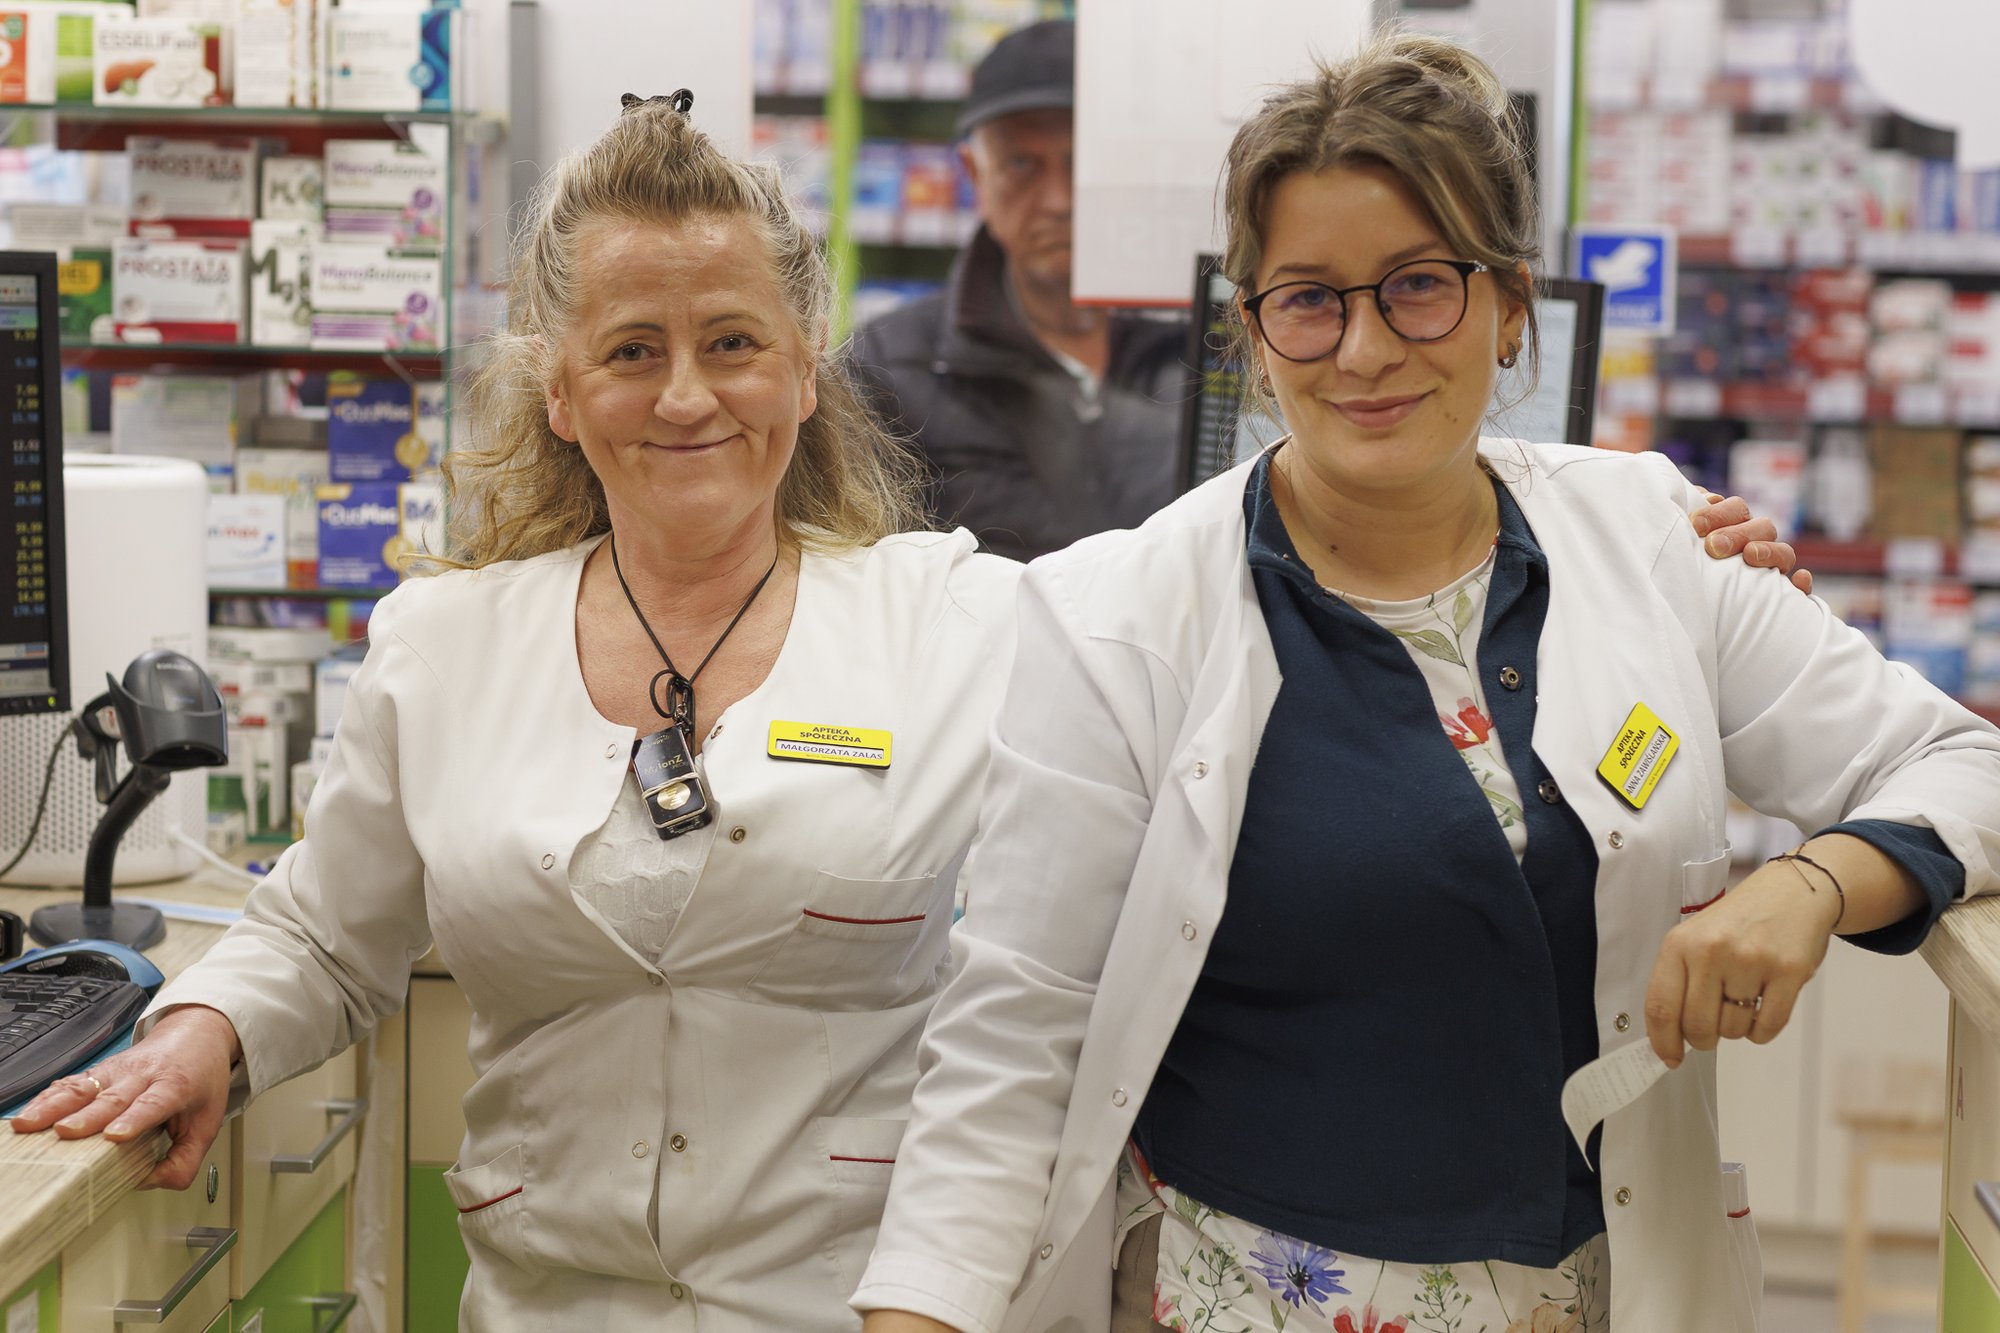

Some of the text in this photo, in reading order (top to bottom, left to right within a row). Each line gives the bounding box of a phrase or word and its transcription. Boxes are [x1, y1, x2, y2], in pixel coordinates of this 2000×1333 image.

[133, 154, 242, 177] PROSTATA
[120, 256, 229, 279] PROSTATA
[799, 732, 862, 743] SPOŁECZNA
[812, 726, 850, 735] APTEKA
[1617, 729, 1635, 754] APTEKA
[780, 743, 850, 757] MAŁGORZATA
[852, 752, 883, 760] ZALAS
[1620, 729, 1647, 769] SPOŁECZNA
[1625, 775, 1642, 796] ANNA
